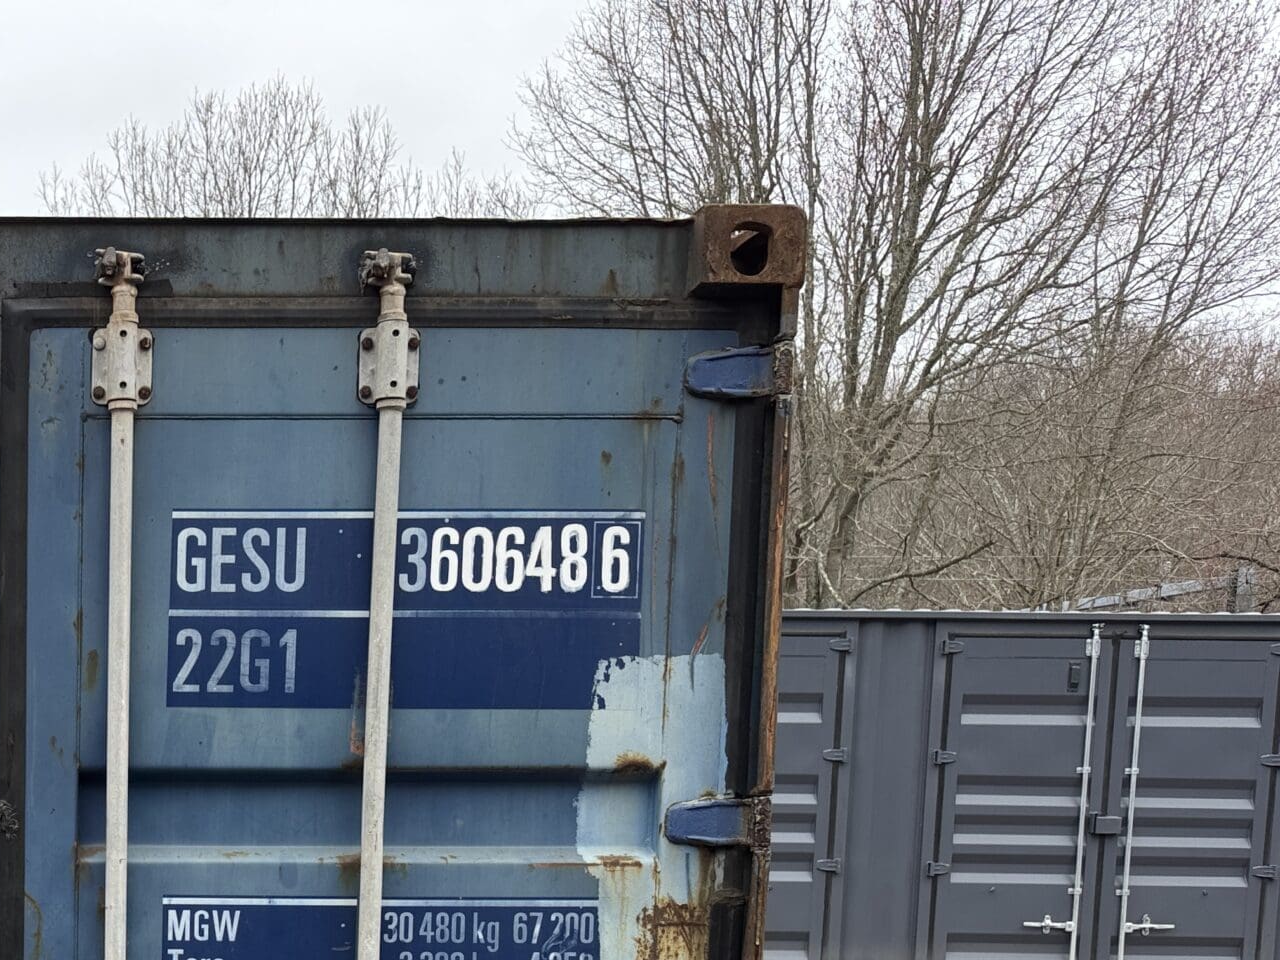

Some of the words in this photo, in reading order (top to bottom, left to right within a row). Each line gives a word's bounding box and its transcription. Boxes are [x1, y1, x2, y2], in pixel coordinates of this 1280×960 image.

[176, 527, 307, 593] GESU
[172, 628, 298, 694] 22G1
[167, 910, 240, 942] MGW
[472, 913, 500, 952] kg
